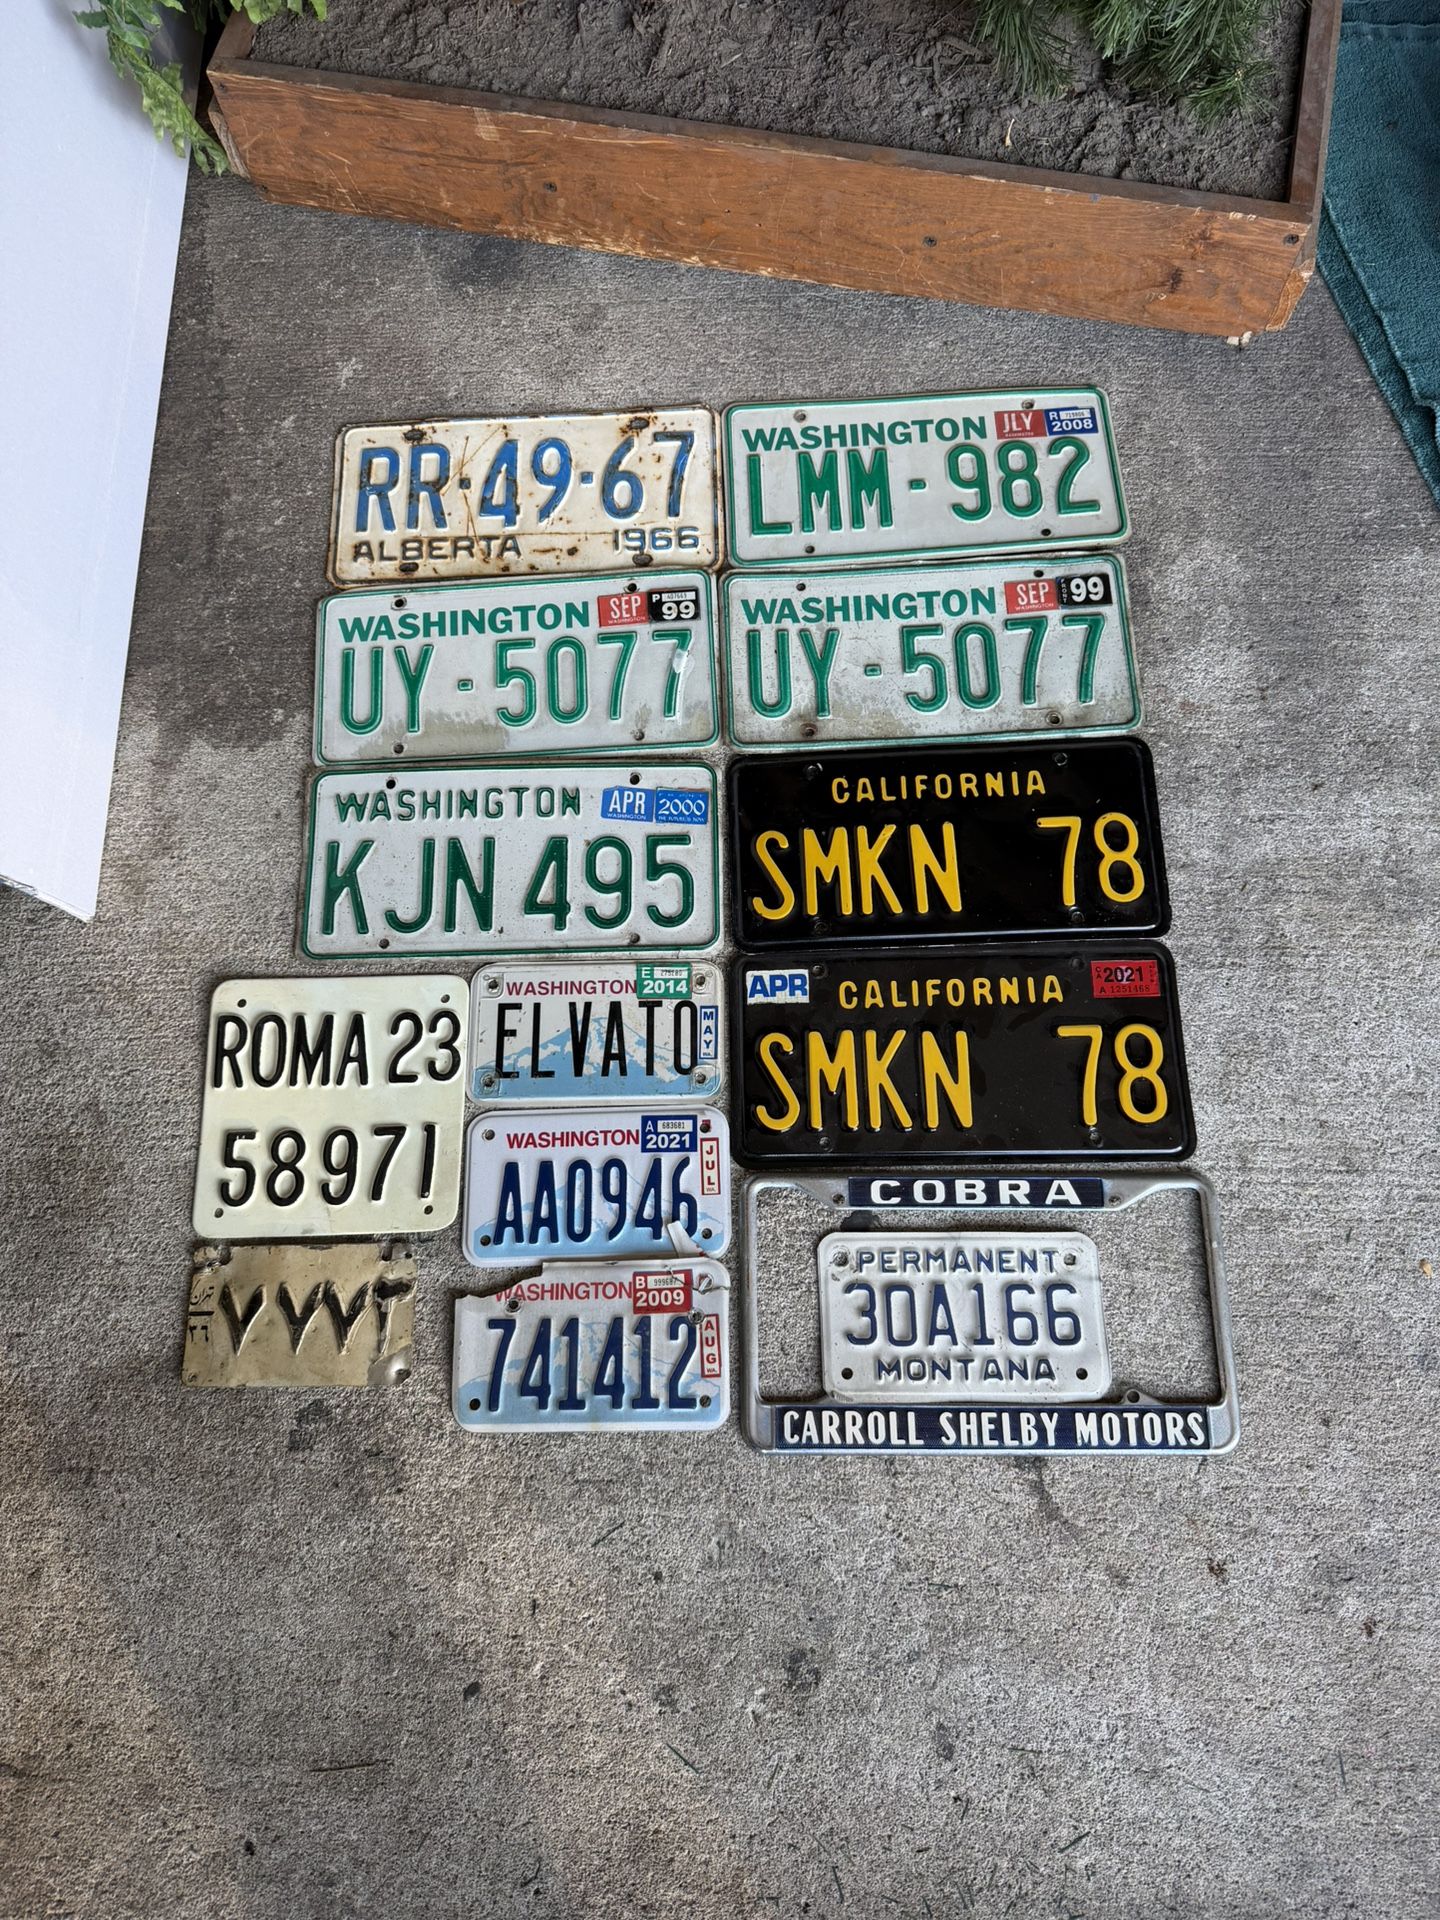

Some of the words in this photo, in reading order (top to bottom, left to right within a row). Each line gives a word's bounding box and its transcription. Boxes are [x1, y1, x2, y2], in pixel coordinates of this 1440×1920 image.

[1003, 412, 1032, 433] JLY
[1049, 411, 1058, 420] R
[1051, 419, 1093, 432] 2008
[741, 415, 989, 452] WASHINGTON
[352, 534, 522, 563] ALBERTA
[613, 526, 700, 552] 1966
[652, 593, 660, 602] P
[1016, 582, 1049, 605] SEP
[1070, 576, 1104, 602] 99
[609, 595, 641, 619] SEP
[662, 601, 695, 620] 99
[741, 587, 997, 625] WASHINGTON
[339, 601, 590, 643] WASHINGTON
[832, 770, 1045, 804] CALIFORNIA
[335, 787, 583, 822] WASHINGTON
[608, 790, 646, 814] APR
[658, 798, 705, 816] 2000
[752, 822, 962, 921] SMKN
[1037, 812, 1145, 905] 78
[321, 836, 496, 935] KJN
[523, 833, 695, 932] 495
[642, 967, 651, 978] E
[1103, 966, 1144, 982] 2021
[506, 979, 638, 997] WASHINGTON
[642, 980, 688, 994] 2014
[748, 973, 808, 999] APR
[839, 975, 1064, 1009] CALIFORNIA
[703, 1011, 714, 1049] MAY
[213, 1012, 368, 1088] ROMA
[388, 1010, 462, 1083] 23
[756, 1029, 974, 1131] SMKN
[1057, 1023, 1168, 1126] 78
[645, 1120, 654, 1132] A
[506, 1130, 639, 1150] WASHINGTON
[646, 1133, 690, 1148] 2021
[219, 1123, 437, 1207] 58971
[705, 1145, 715, 1186] JUL
[870, 1179, 1082, 1205] COBRA
[858, 1250, 1058, 1273] PERMANENT
[635, 1276, 645, 1289] B
[636, 1290, 685, 1307] 2009
[704, 1320, 717, 1364] AUG
[487, 1315, 698, 1412] 741412
[876, 1359, 1057, 1382] MONTANA
[782, 1411, 924, 1446] CARROLL
[942, 1411, 1058, 1447] SHELBY
[1074, 1410, 1206, 1446] MOTORS
